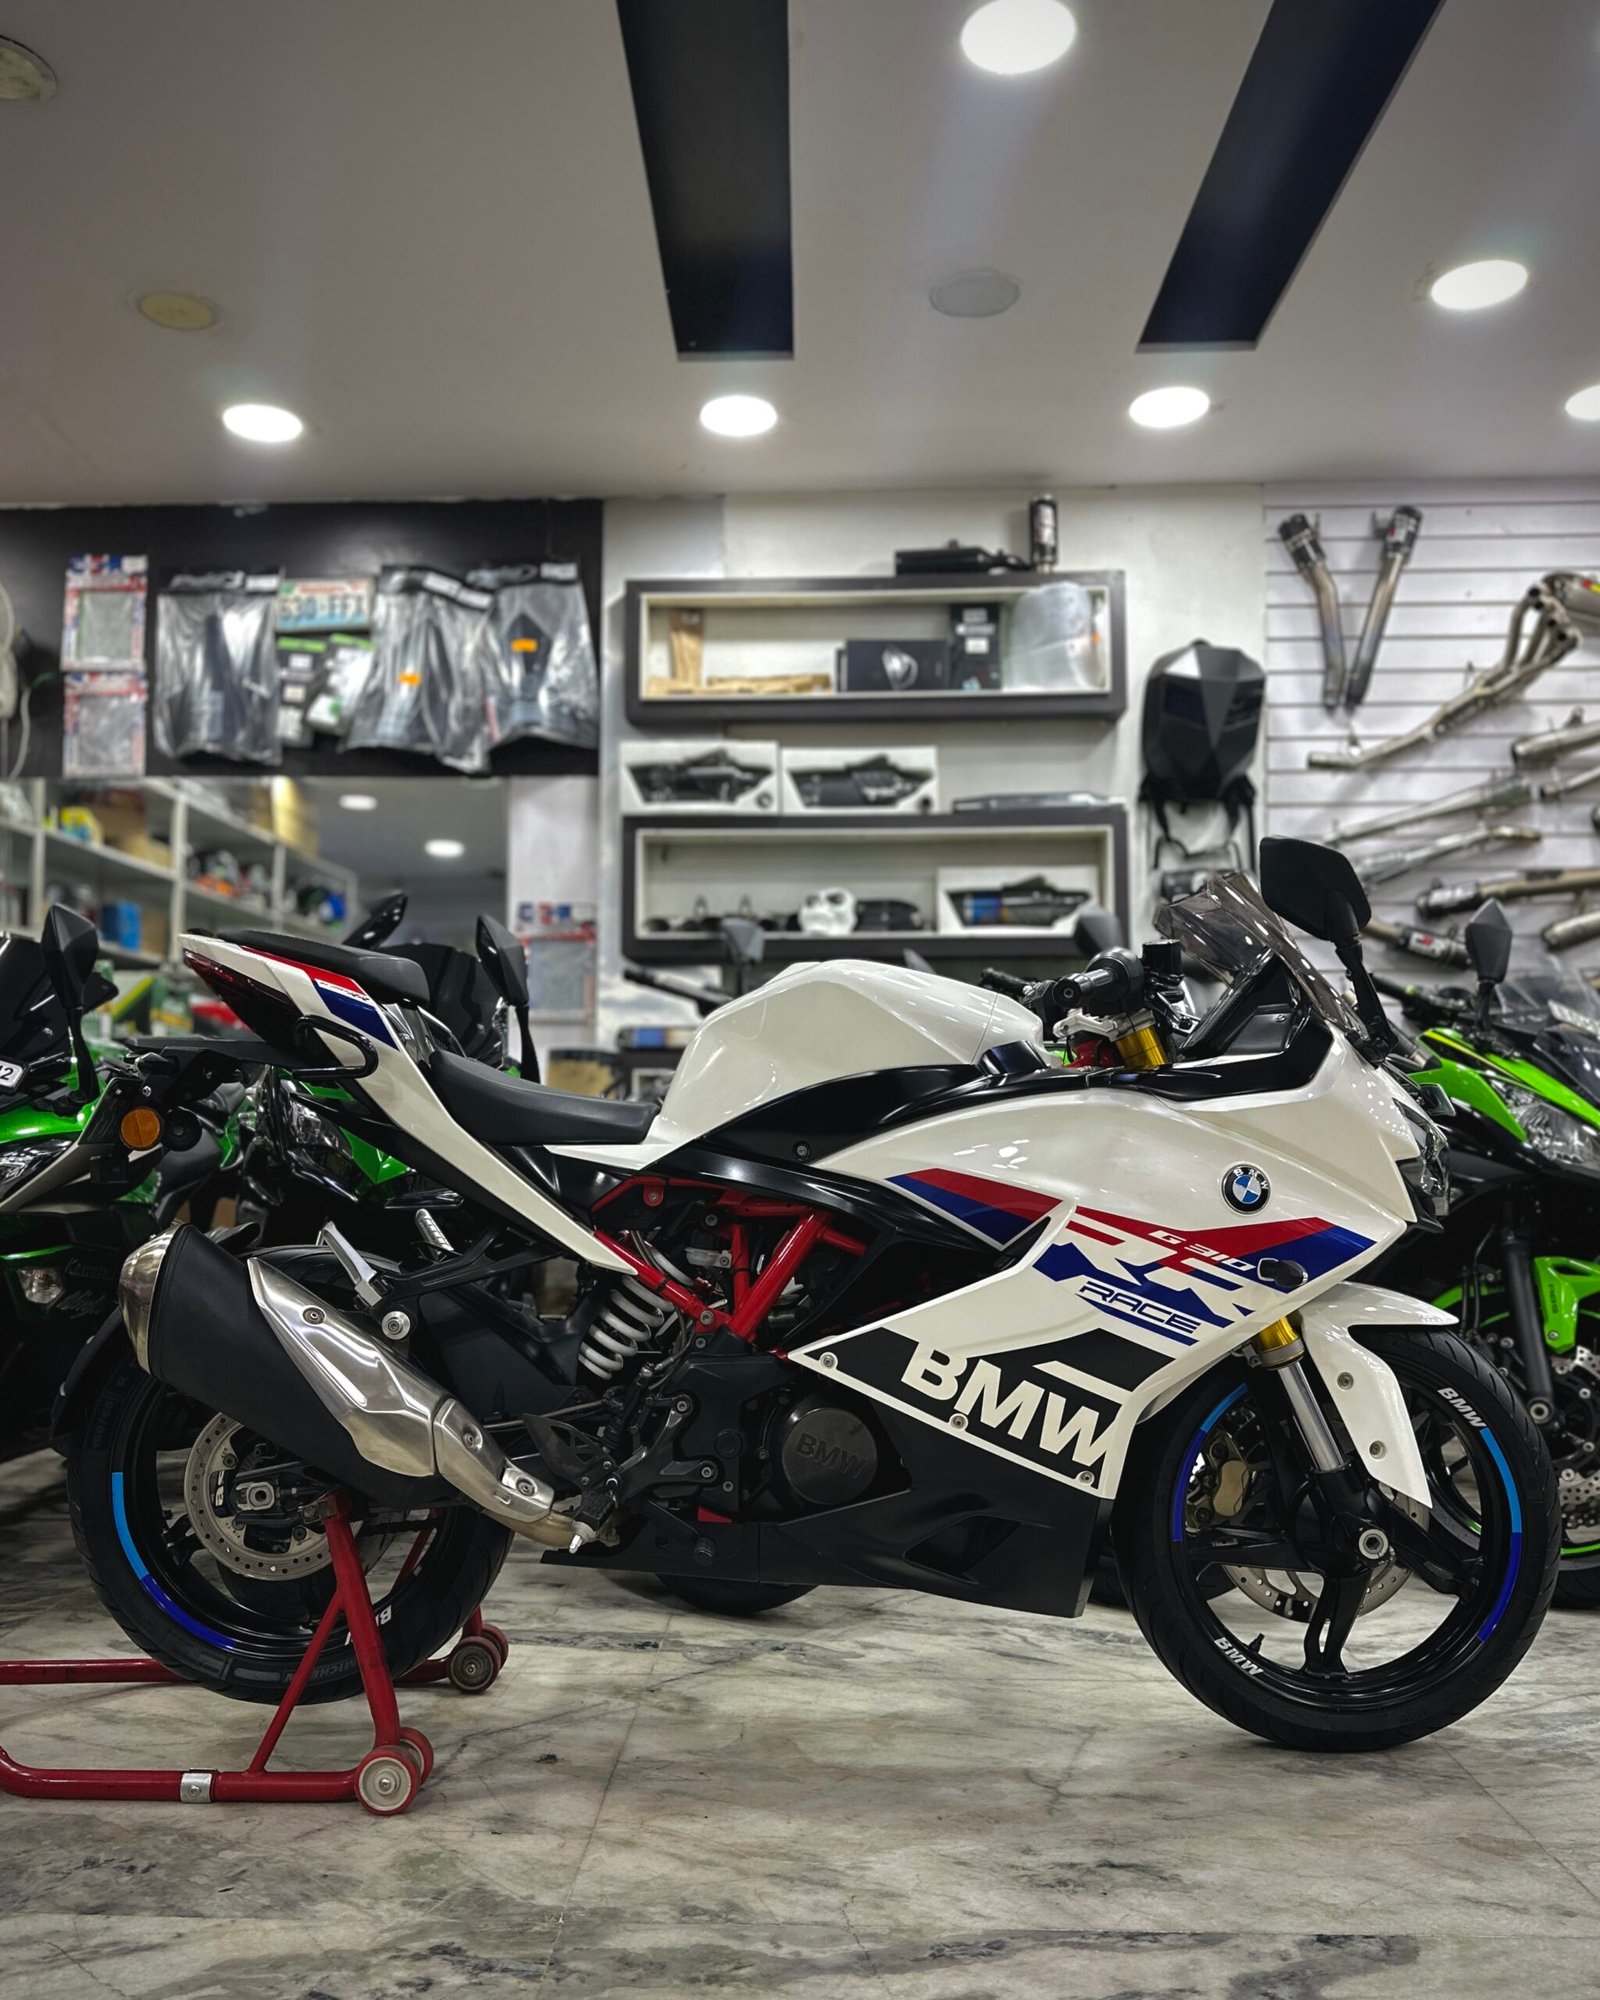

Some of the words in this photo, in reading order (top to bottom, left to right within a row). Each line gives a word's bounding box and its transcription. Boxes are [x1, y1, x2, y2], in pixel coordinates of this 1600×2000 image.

[1233, 1167, 1269, 1190] BMW
[1148, 1229, 1186, 1245] G
[1184, 1243, 1256, 1271] 310
[1079, 1281, 1201, 1334] RACE
[901, 1345, 1121, 1467] BMW
[1437, 1387, 1488, 1427] BMW
[797, 1434, 867, 1479] BMW
[1214, 1637, 1264, 1675] BMW
